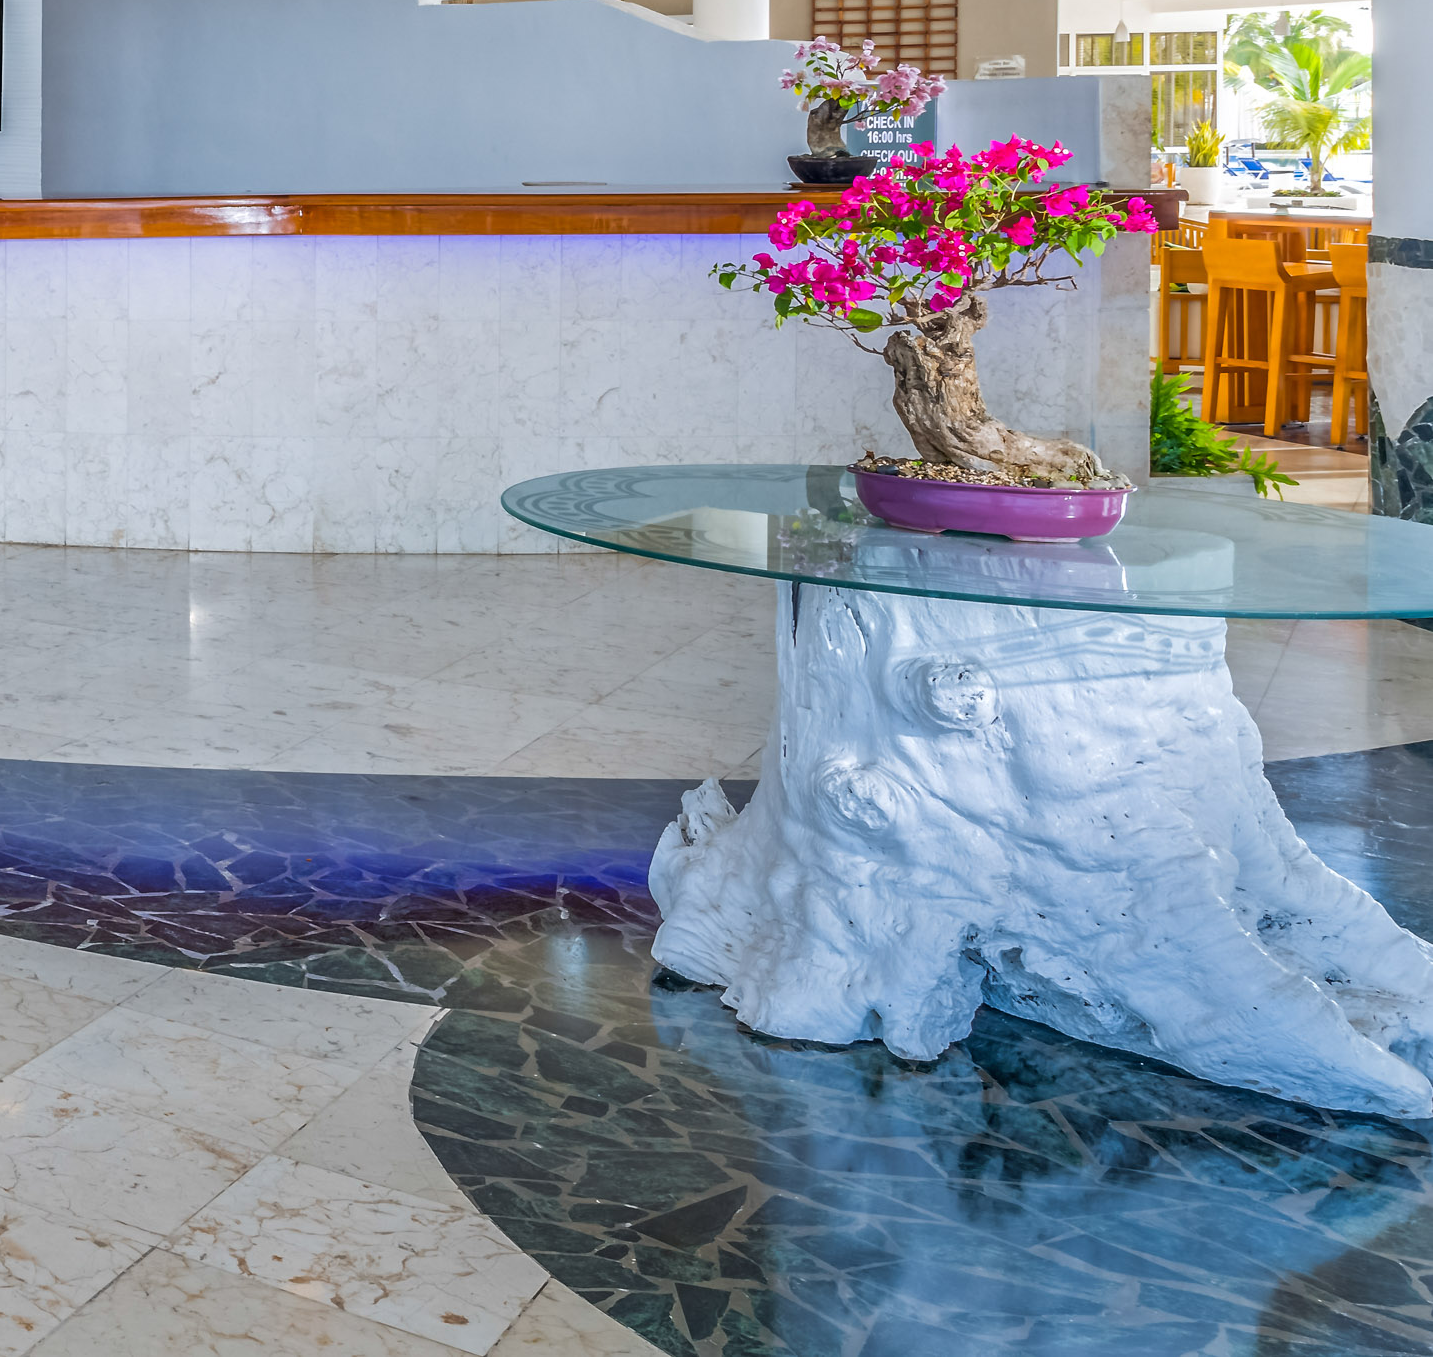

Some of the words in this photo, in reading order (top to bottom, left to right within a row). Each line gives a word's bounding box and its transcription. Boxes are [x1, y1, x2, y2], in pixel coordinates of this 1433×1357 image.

[866, 115, 901, 129] CHECK
[903, 115, 915, 129] IN
[866, 131, 894, 144] 16:00
[895, 130, 913, 144] hrs
